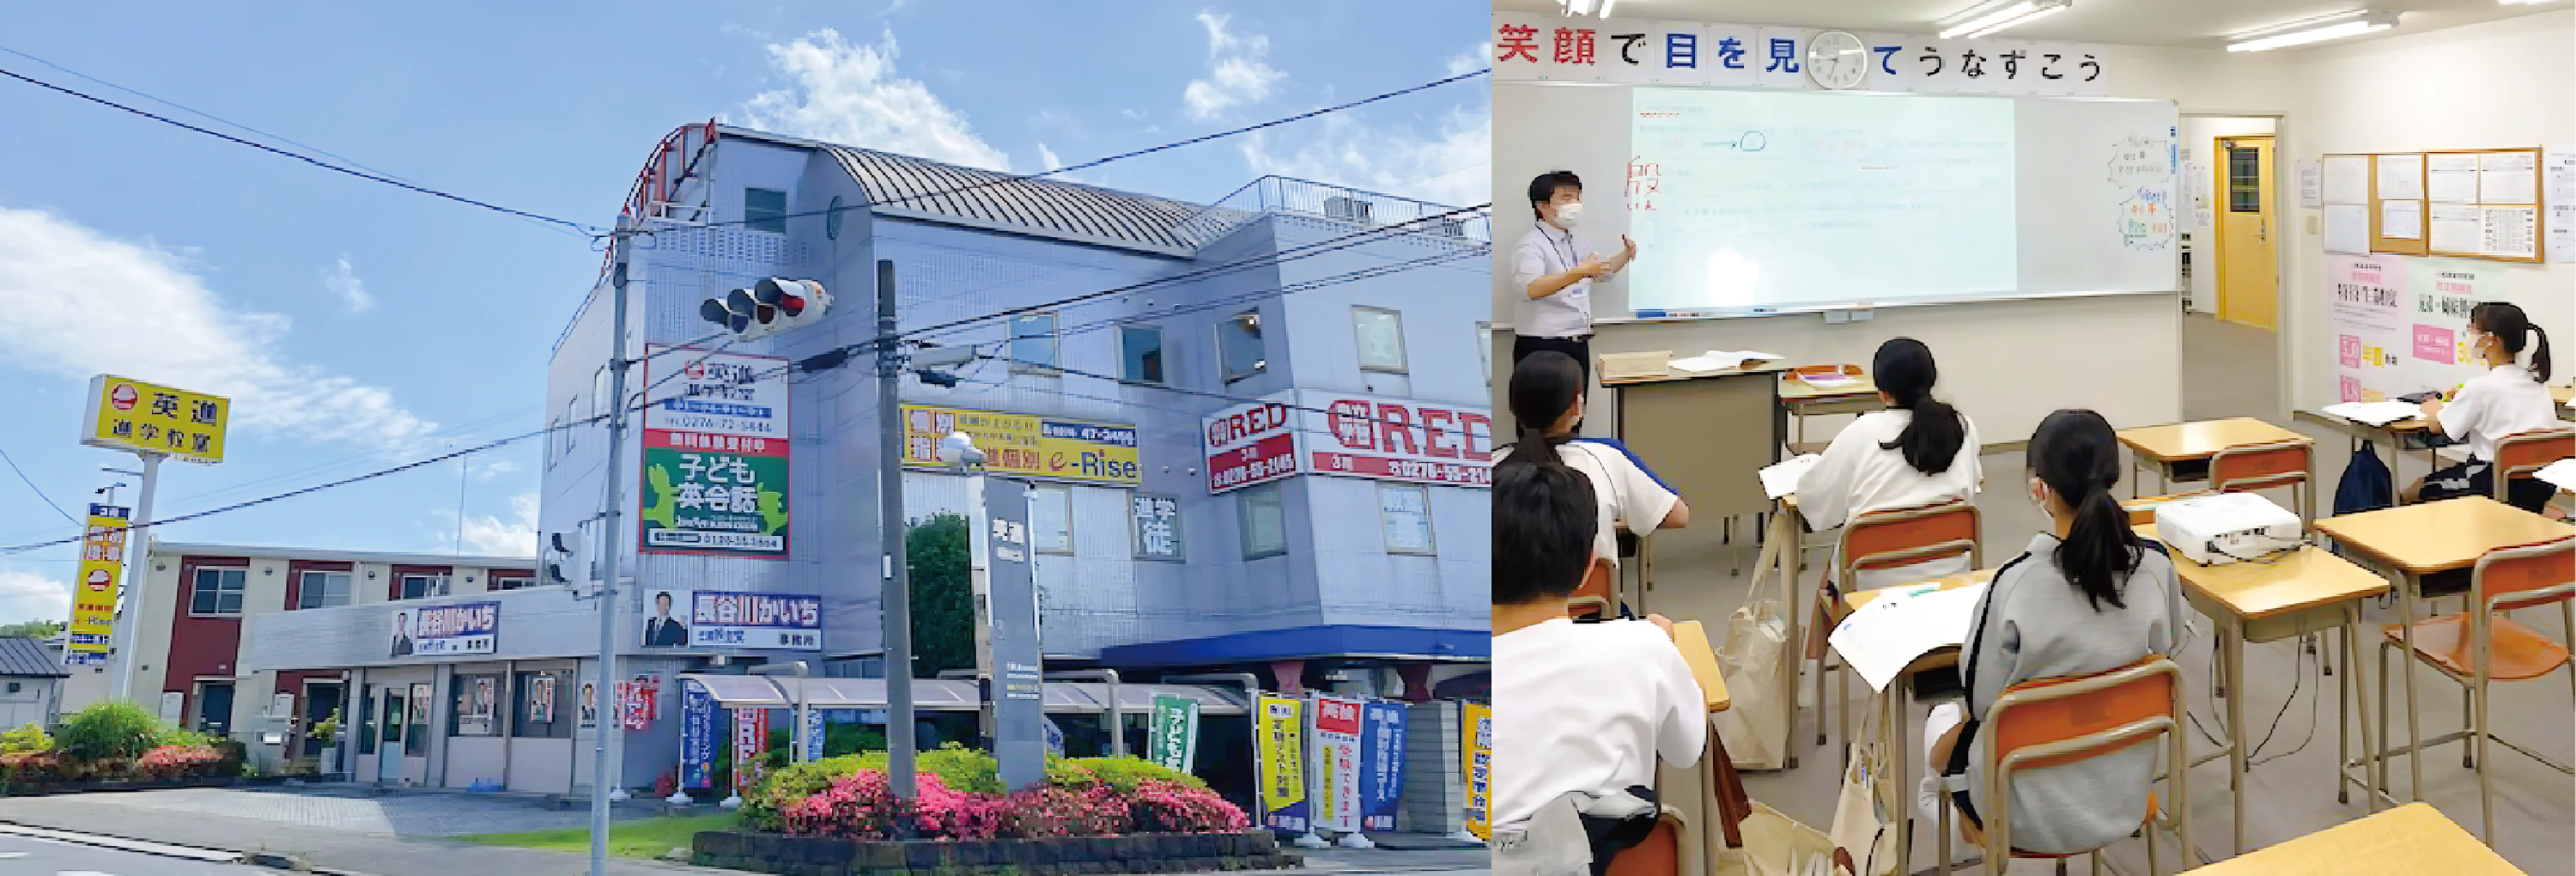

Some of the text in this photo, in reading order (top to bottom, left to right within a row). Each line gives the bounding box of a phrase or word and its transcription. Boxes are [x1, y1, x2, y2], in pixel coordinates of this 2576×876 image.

[1230, 403, 1286, 440] RED
[1377, 403, 1492, 462] RED
[678, 453, 756, 484] 子ども
[677, 483, 759, 514] 英会話
[418, 605, 495, 636] 長谷川かいち
[695, 596, 819, 626] 長谷川かいち
